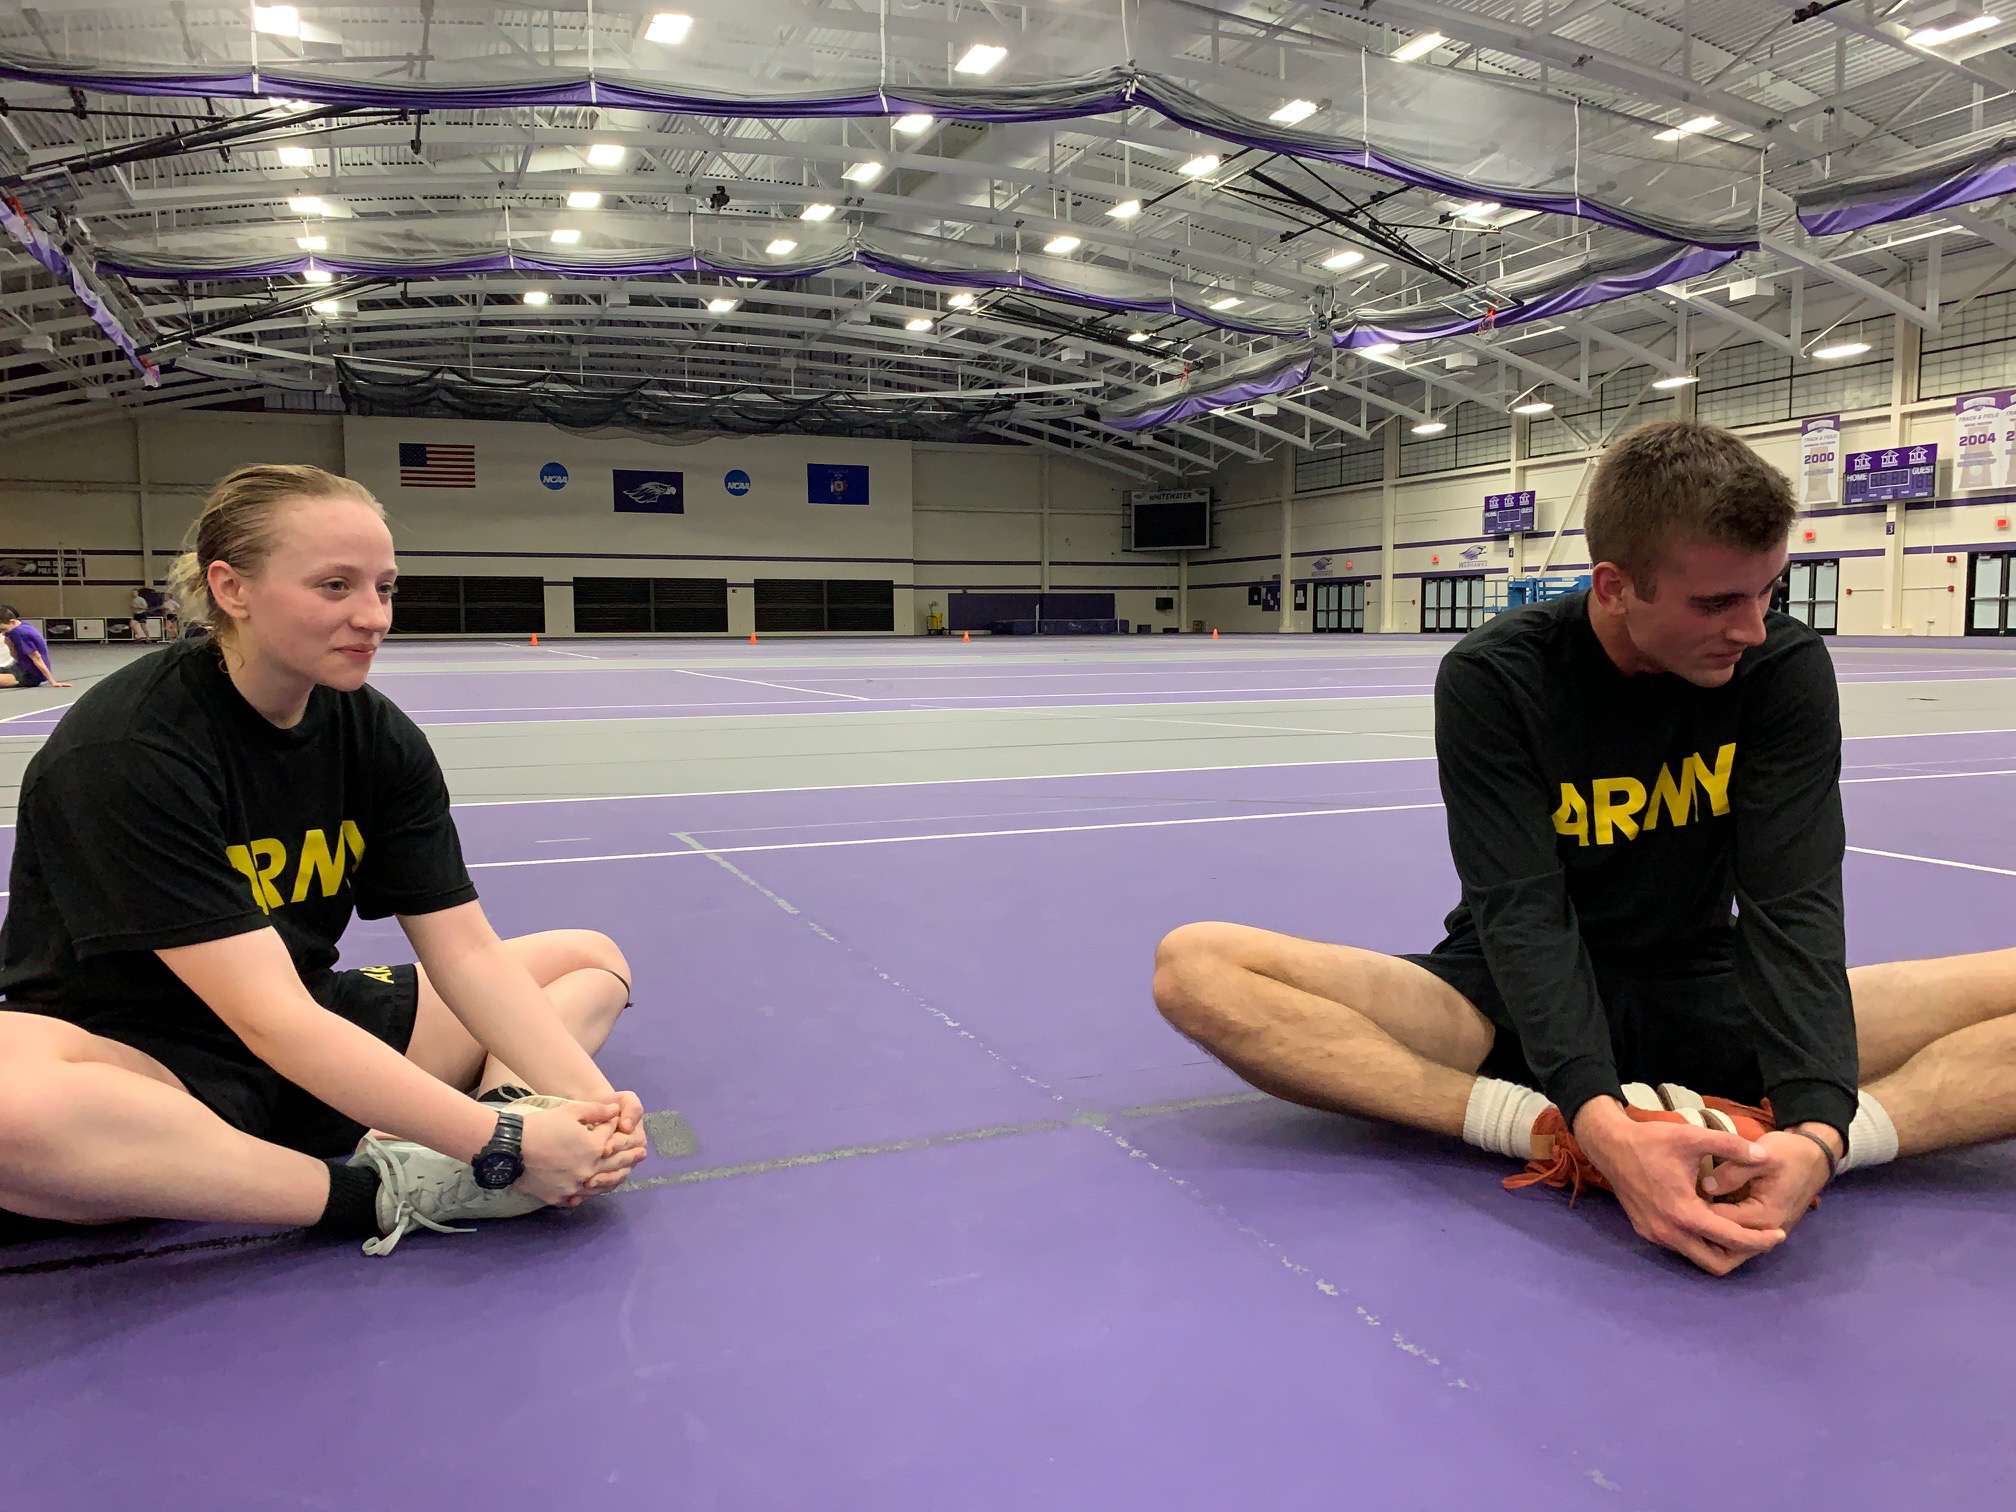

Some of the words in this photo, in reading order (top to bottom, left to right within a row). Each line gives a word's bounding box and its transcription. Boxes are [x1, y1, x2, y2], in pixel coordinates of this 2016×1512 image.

[1958, 432, 1997, 447] 2004
[1804, 452, 1835, 465] 2000
[1911, 466, 1934, 475] GUEST
[542, 475, 568, 484] NCAA
[1846, 473, 1868, 482] HOME
[727, 481, 750, 490] NCAA
[1149, 492, 1192, 500] WHITEWATER
[1551, 742, 1737, 847] ARMY
